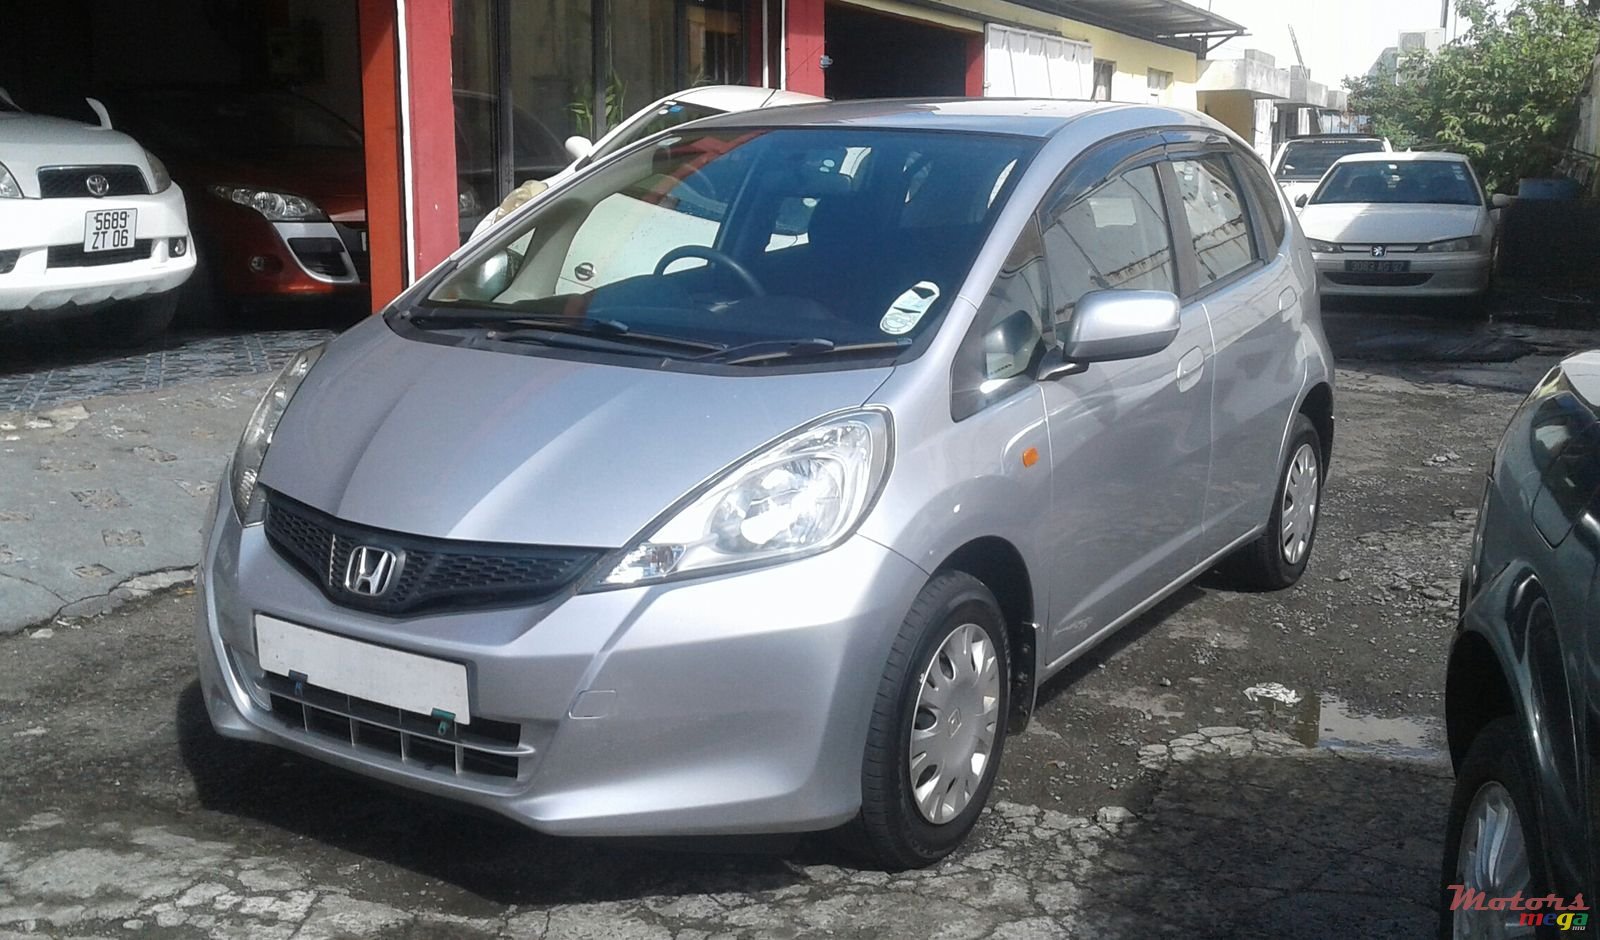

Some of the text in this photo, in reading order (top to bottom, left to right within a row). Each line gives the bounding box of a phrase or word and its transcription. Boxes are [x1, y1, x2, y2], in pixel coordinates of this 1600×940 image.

[95, 211, 128, 231] 5689
[92, 229, 129, 250] ZT 06
